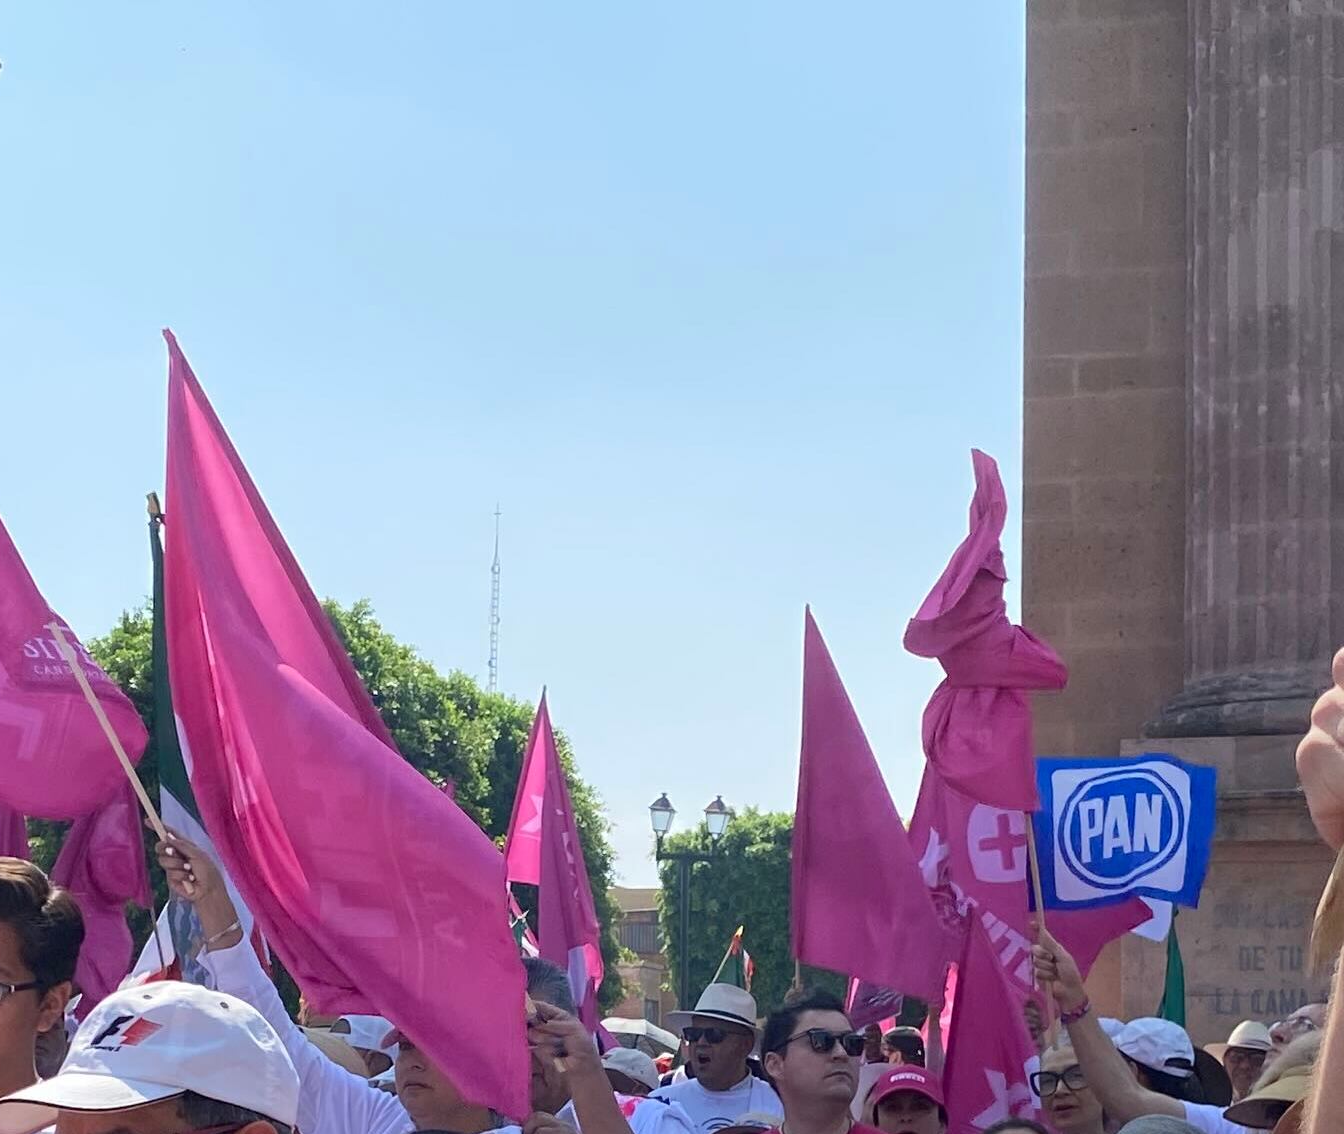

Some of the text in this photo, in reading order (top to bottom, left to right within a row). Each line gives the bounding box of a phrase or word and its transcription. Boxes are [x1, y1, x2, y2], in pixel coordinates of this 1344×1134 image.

[1079, 793, 1162, 864] PAN
[1239, 945, 1303, 971] DE TU
